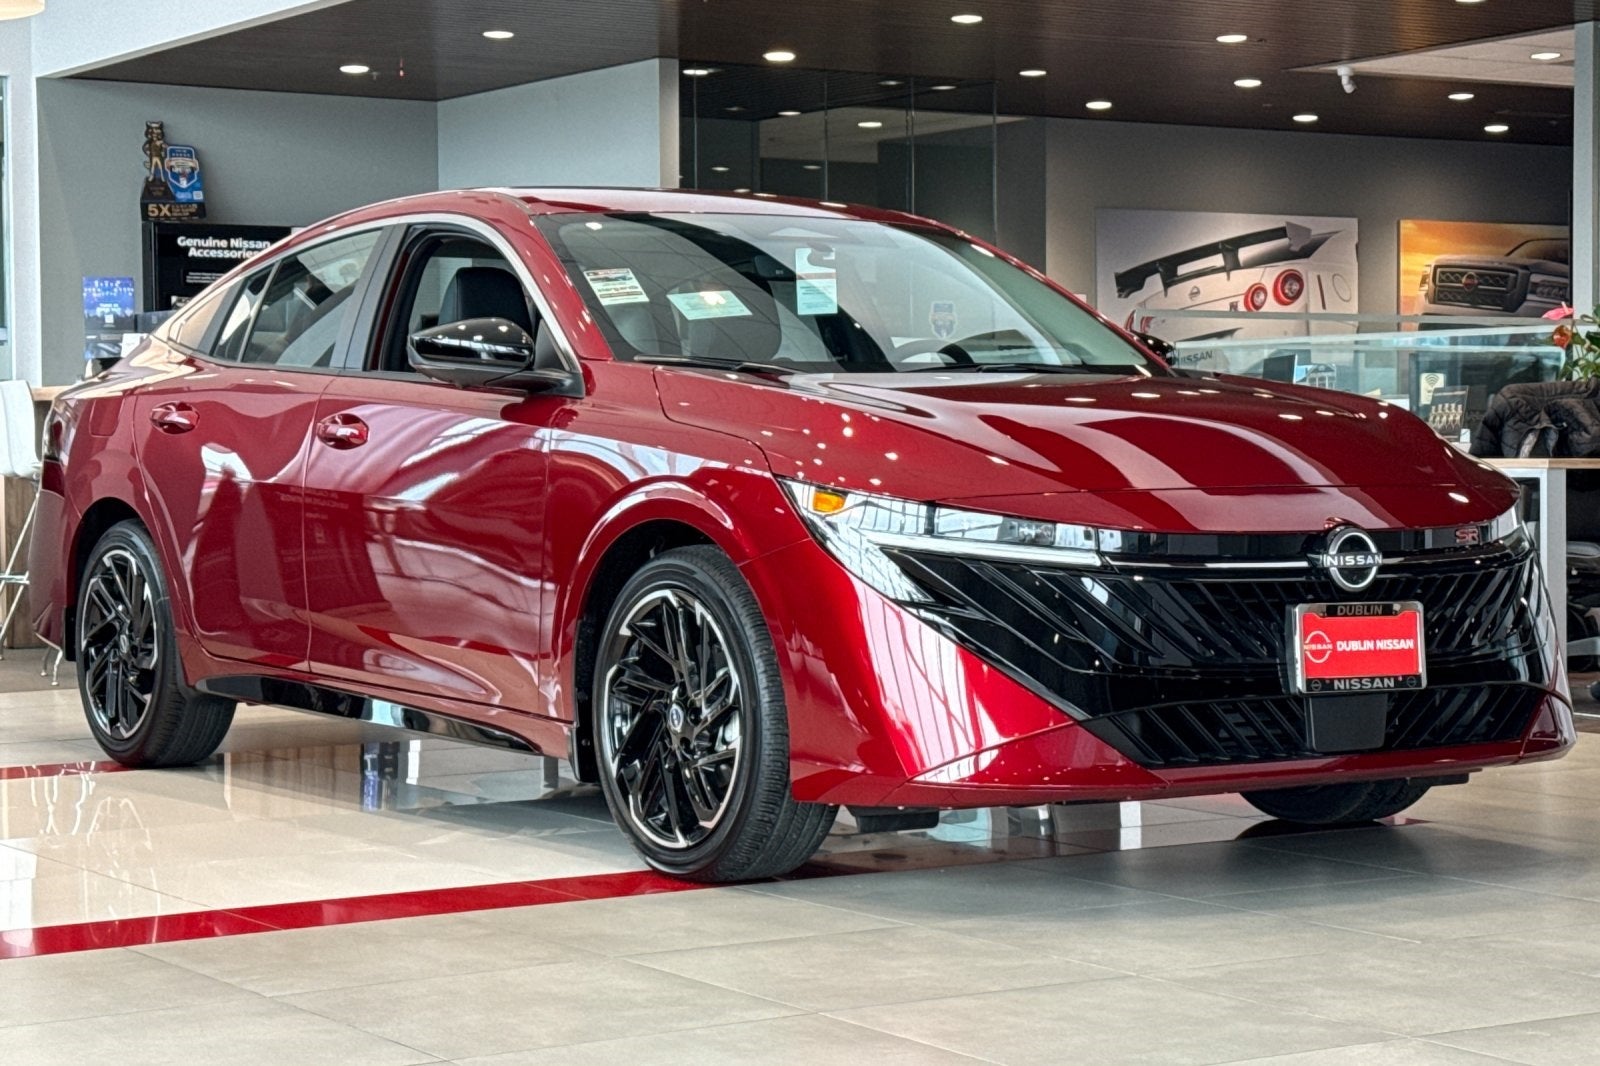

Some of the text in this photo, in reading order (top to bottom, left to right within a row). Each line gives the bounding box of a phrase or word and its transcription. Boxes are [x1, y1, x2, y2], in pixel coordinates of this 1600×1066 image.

[148, 203, 171, 217] 5X
[177, 236, 271, 249] Genuine Nissan
[1456, 528, 1479, 544] SR
[1326, 554, 1382, 567] NISSAN
[1336, 604, 1383, 616] DUBLIN
[1303, 643, 1333, 651] NISSAN
[1336, 639, 1415, 652] DUBLIN NISSAN
[1333, 677, 1395, 691] NISSAN
